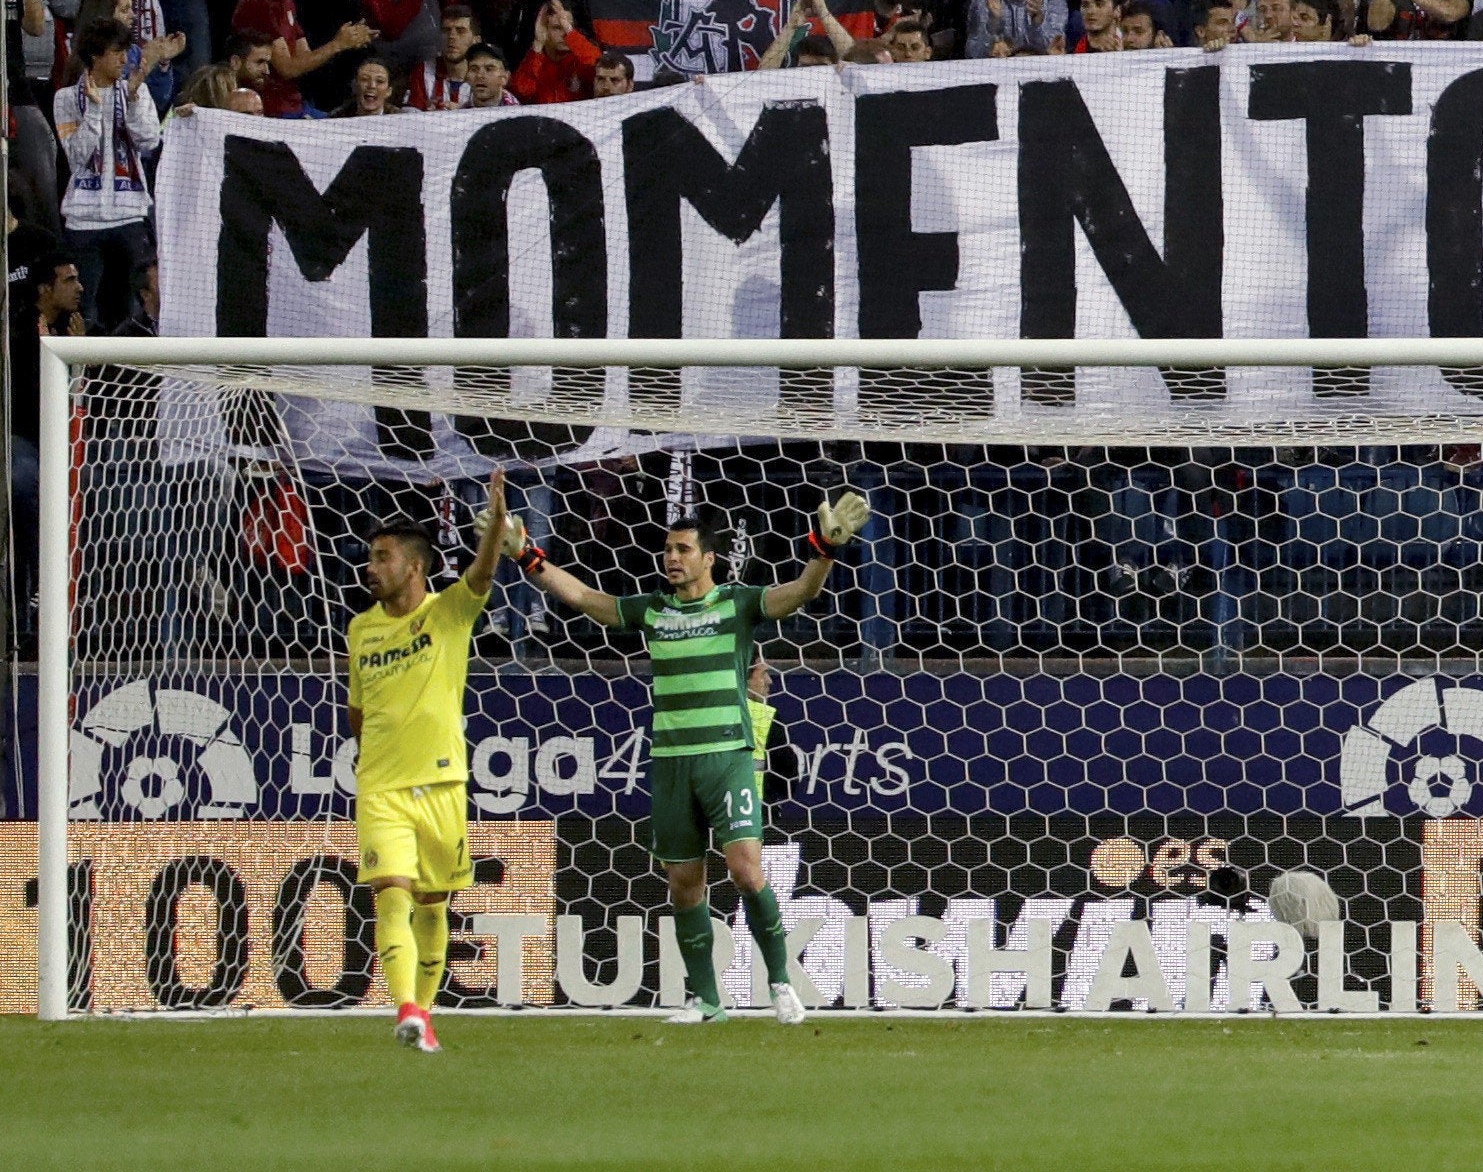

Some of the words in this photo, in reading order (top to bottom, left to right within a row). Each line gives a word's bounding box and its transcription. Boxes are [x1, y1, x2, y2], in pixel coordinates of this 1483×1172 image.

[357, 632, 434, 672] PAMESA
[722, 787, 755, 819] 13
[470, 913, 1053, 1010] TURKISH
